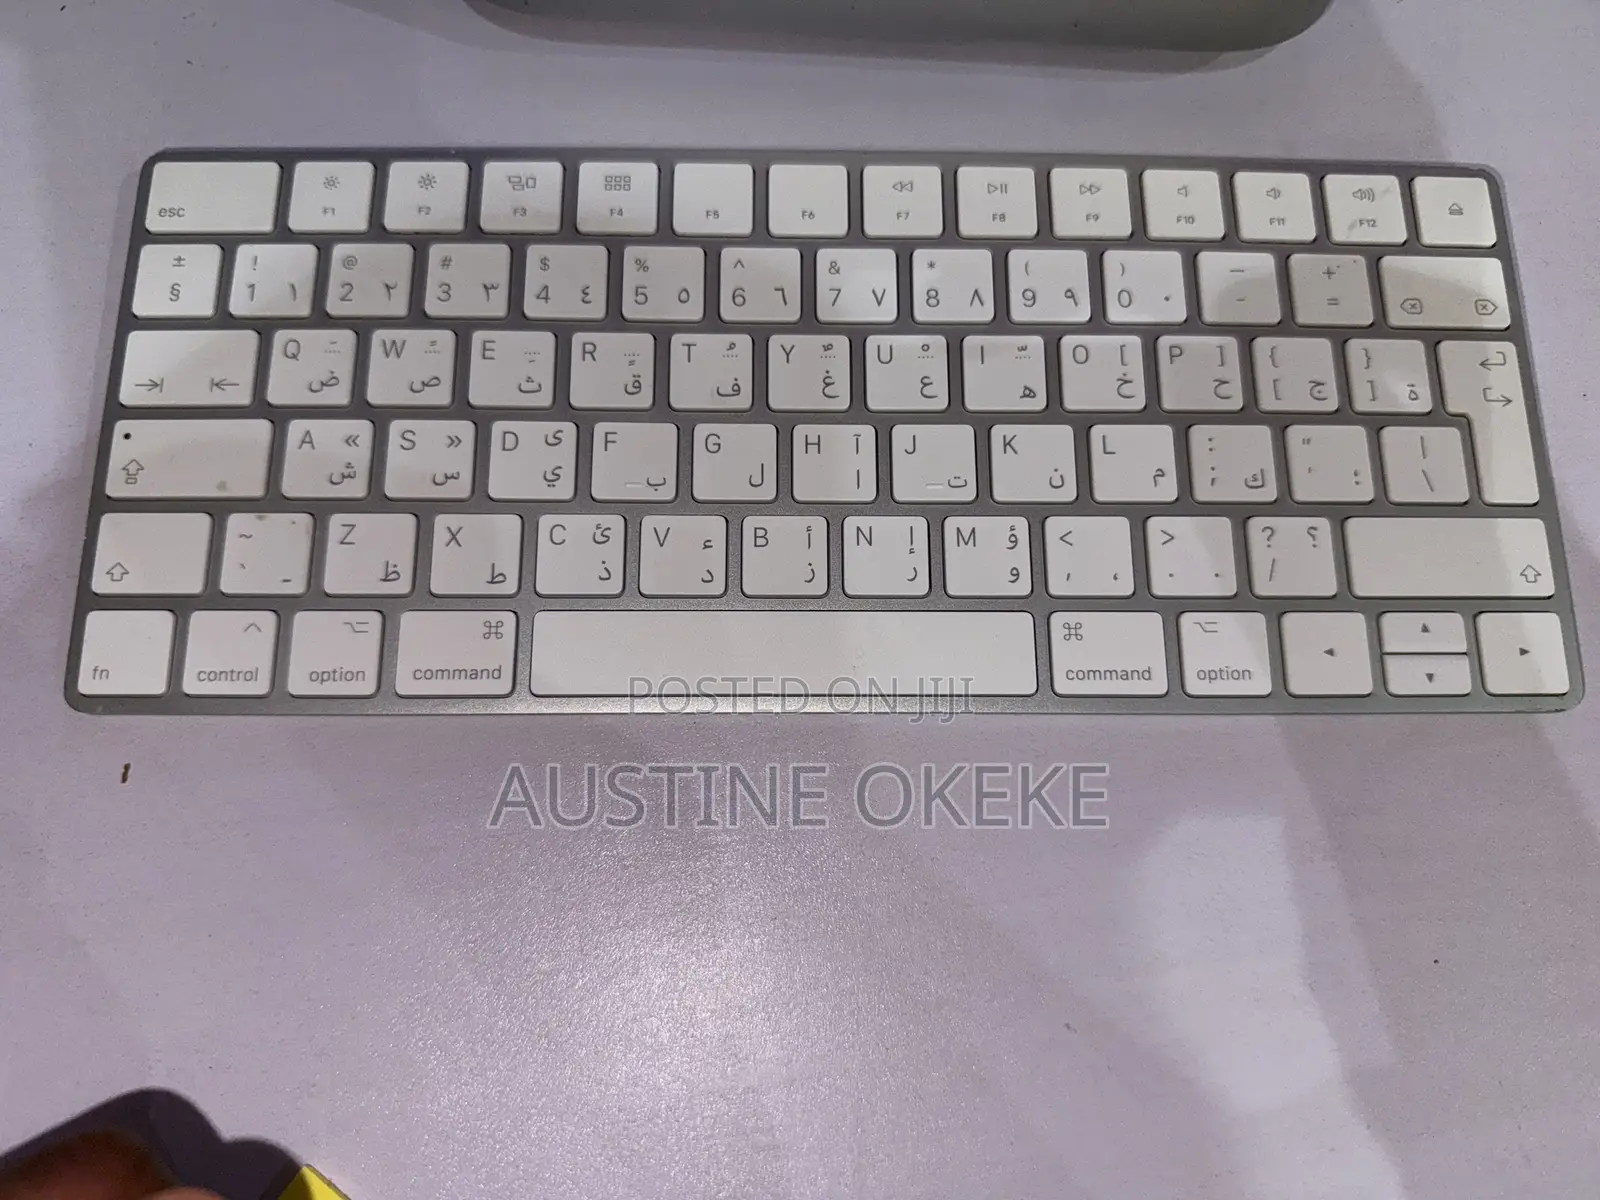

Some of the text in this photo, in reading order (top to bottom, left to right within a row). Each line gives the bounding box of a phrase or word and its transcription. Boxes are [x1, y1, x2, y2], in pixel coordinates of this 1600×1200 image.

[158, 207, 185, 218] esc
[513, 207, 527, 217] F3
[609, 208, 623, 217] F4
[801, 209, 815, 220] F6
[896, 211, 910, 220] F7
[992, 212, 1006, 222] F8
[1085, 213, 1100, 222] F9
[1176, 215, 1195, 224] F10
[1269, 217, 1286, 226] F11
[1359, 219, 1378, 228] F12
[172, 255, 186, 267] ±
[343, 256, 357, 270] @
[441, 256, 452, 269] #
[540, 256, 550, 271] $
[635, 258, 649, 272] %
[733, 258, 745, 269] ^
[828, 260, 840, 275] &
[169, 282, 181, 302] §
[247, 283, 256, 302] 1
[339, 282, 354, 302] 2
[436, 282, 451, 302] 3
[535, 284, 551, 304] 4
[634, 285, 648, 305] 5
[731, 287, 746, 307] 6
[829, 287, 841, 307] 7
[925, 287, 940, 308] 8
[1021, 287, 1037, 308] 9
[1117, 288, 1133, 308] 0
[282, 338, 301, 361] Q
[381, 339, 406, 359] W
[480, 339, 496, 360] E
[581, 341, 597, 362] R
[681, 342, 697, 363] T
[780, 344, 795, 364] Y
[877, 344, 893, 365] U
[1072, 344, 1090, 365] O
[1169, 344, 1184, 365] P
[1269, 346, 1279, 368] {
[1362, 347, 1372, 370] }
[1273, 378, 1282, 400] [
[1366, 379, 1378, 402] ]
[297, 429, 315, 450] A
[399, 429, 416, 451] S
[501, 430, 519, 452] D
[604, 431, 618, 452] F
[704, 433, 721, 454] G
[804, 434, 821, 455] H
[904, 434, 917, 455] J
[1002, 434, 1018, 455] K
[1102, 434, 1116, 455] L
[338, 523, 356, 545] Z
[445, 526, 463, 548] X
[549, 523, 567, 546] C
[653, 526, 671, 548] V
[753, 526, 769, 548] B
[856, 525, 873, 547] N
[956, 526, 977, 548] M
[1059, 530, 1074, 547] <
[1160, 529, 1176, 546] >
[1261, 526, 1276, 548] ?
[92, 665, 109, 680] fn
[196, 667, 259, 682] control
[309, 667, 365, 685] option
[413, 664, 502, 680] command
[1065, 666, 1152, 681] command
[1197, 666, 1252, 684] option
